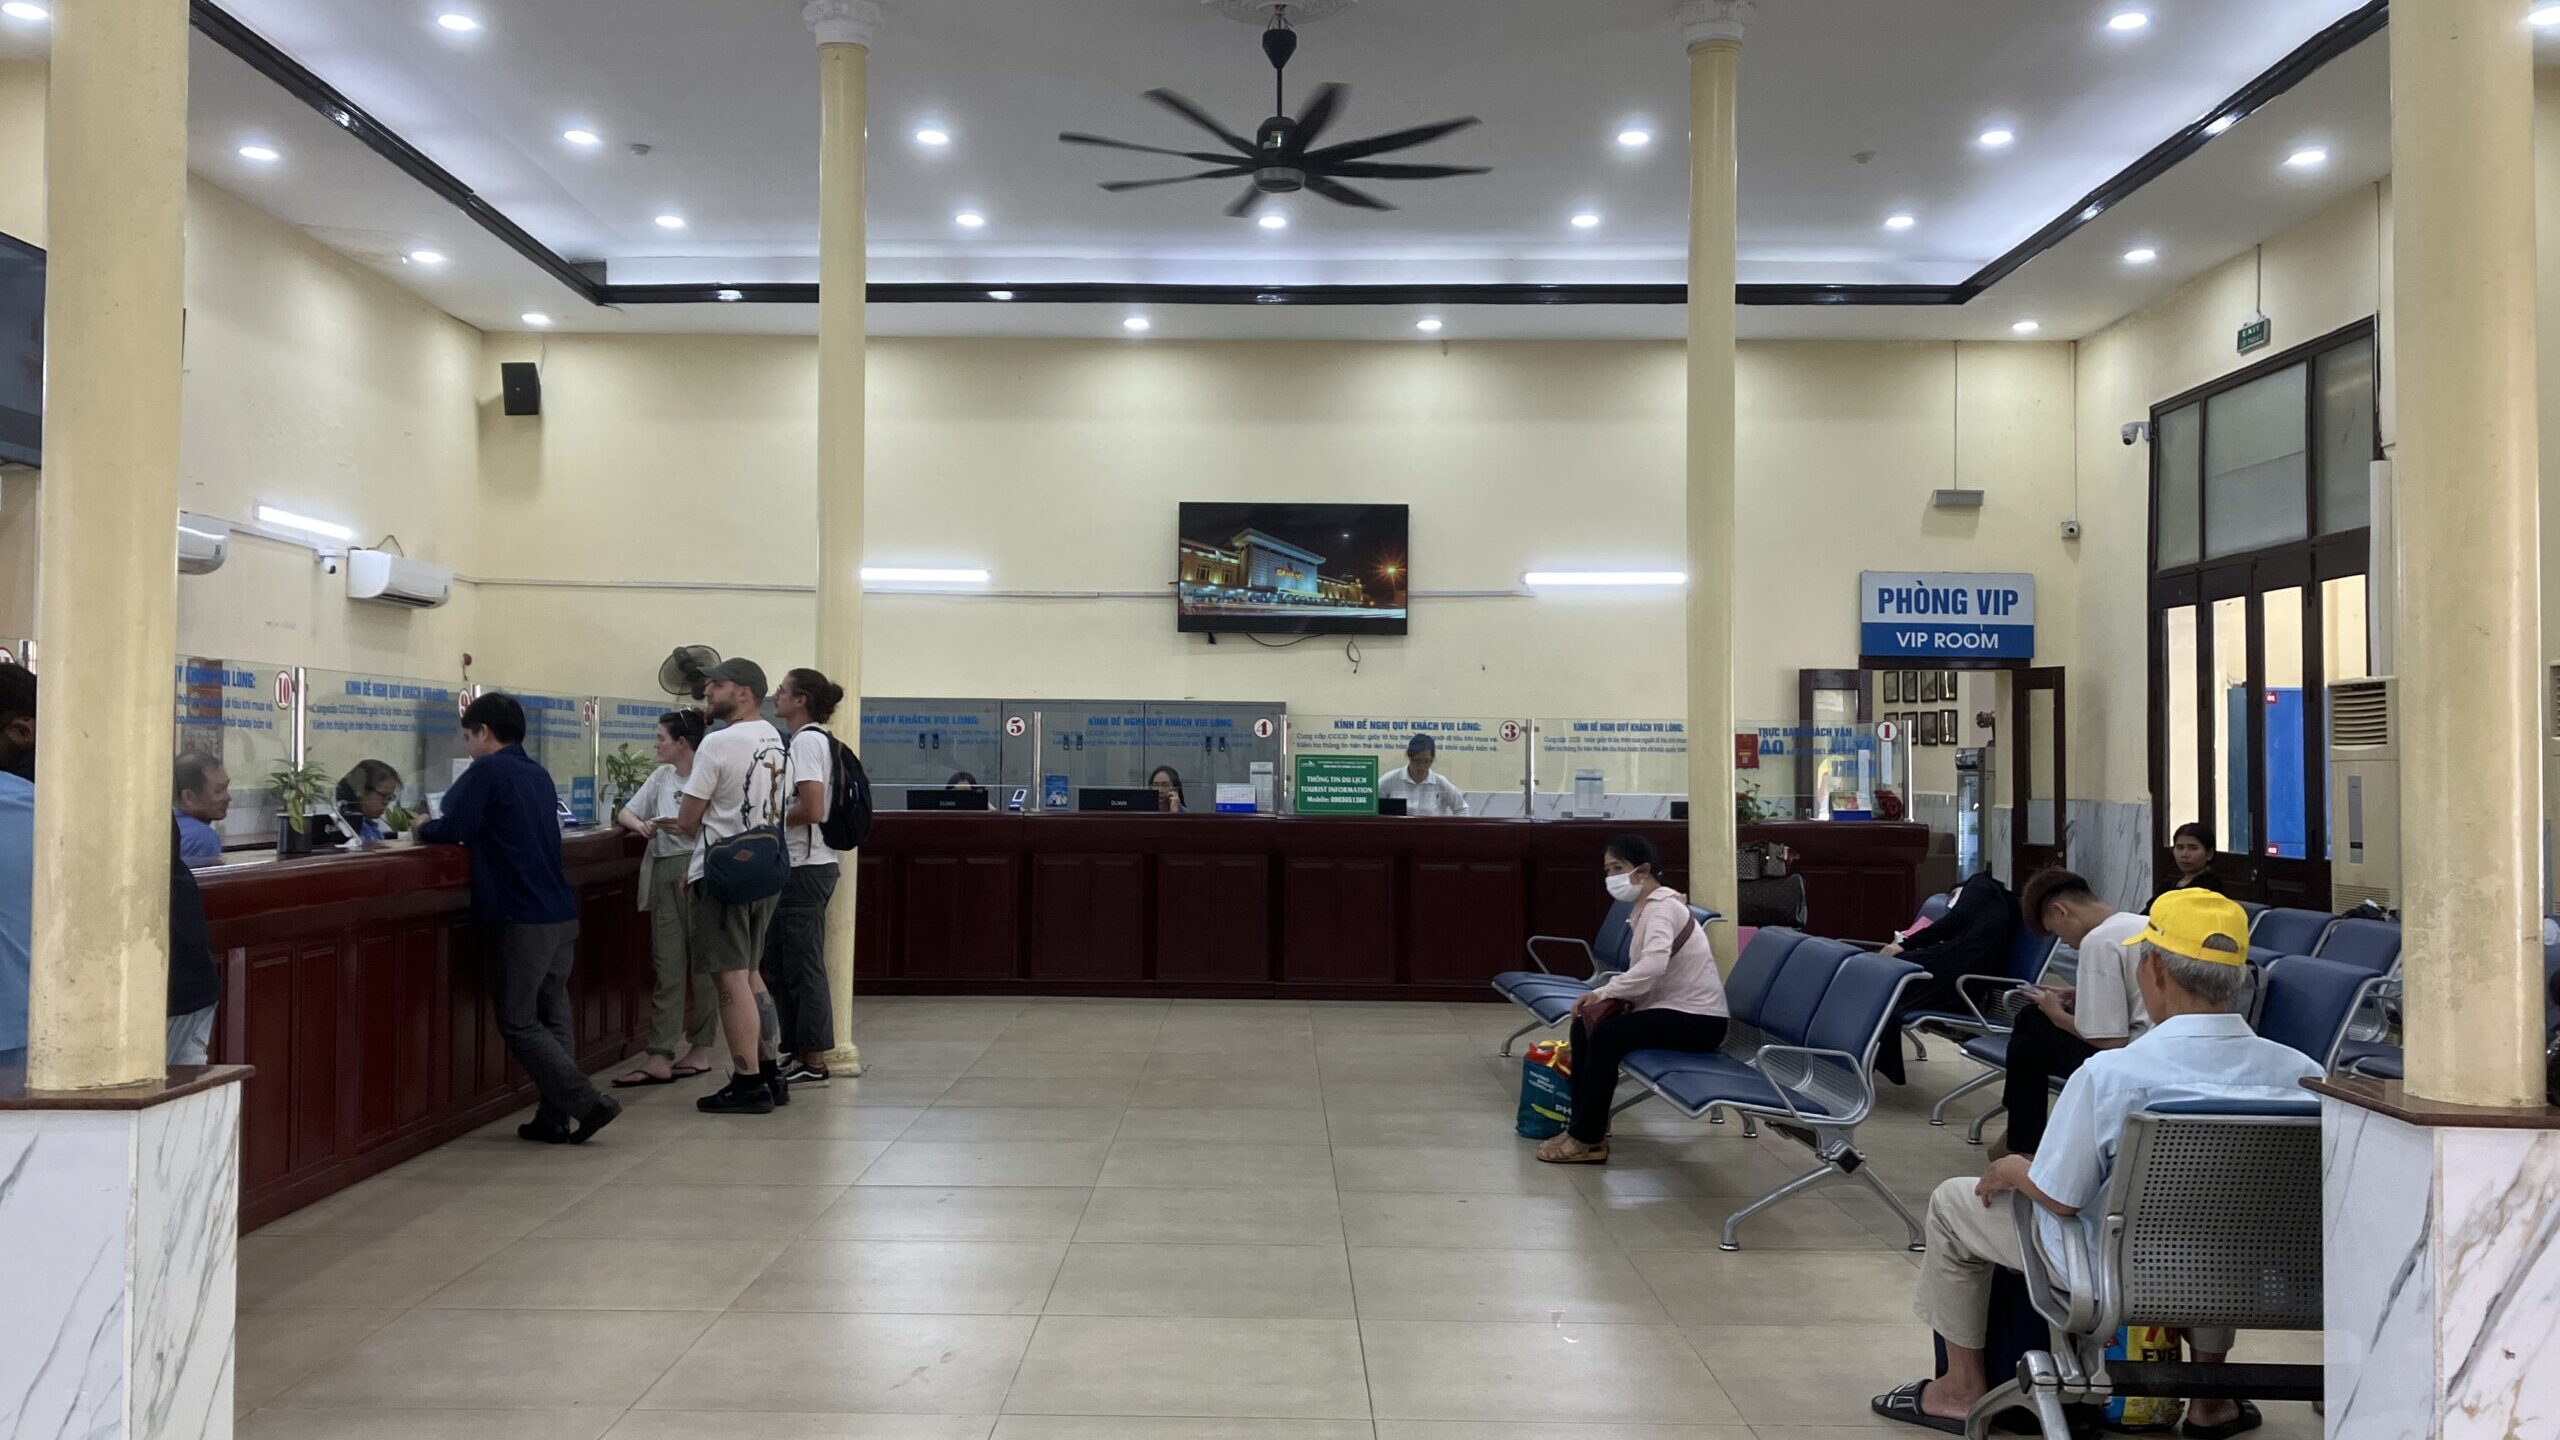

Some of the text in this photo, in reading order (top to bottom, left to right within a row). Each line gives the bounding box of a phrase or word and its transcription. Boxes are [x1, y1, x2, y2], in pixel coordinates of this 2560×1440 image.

[1878, 580, 2019, 616] PHÒNG VIP
[1896, 631, 1999, 649] VIP ROOM
[279, 677, 292, 704] 10
[1010, 719, 1022, 734] 5
[1256, 721, 1268, 736] 4
[1334, 718, 1354, 729] KÍNH
[1411, 720, 1439, 731] KHÁCH
[1441, 721, 1455, 731] VUI
[1504, 723, 1517, 739] 3
[1306, 775, 1330, 783] THÔNG
